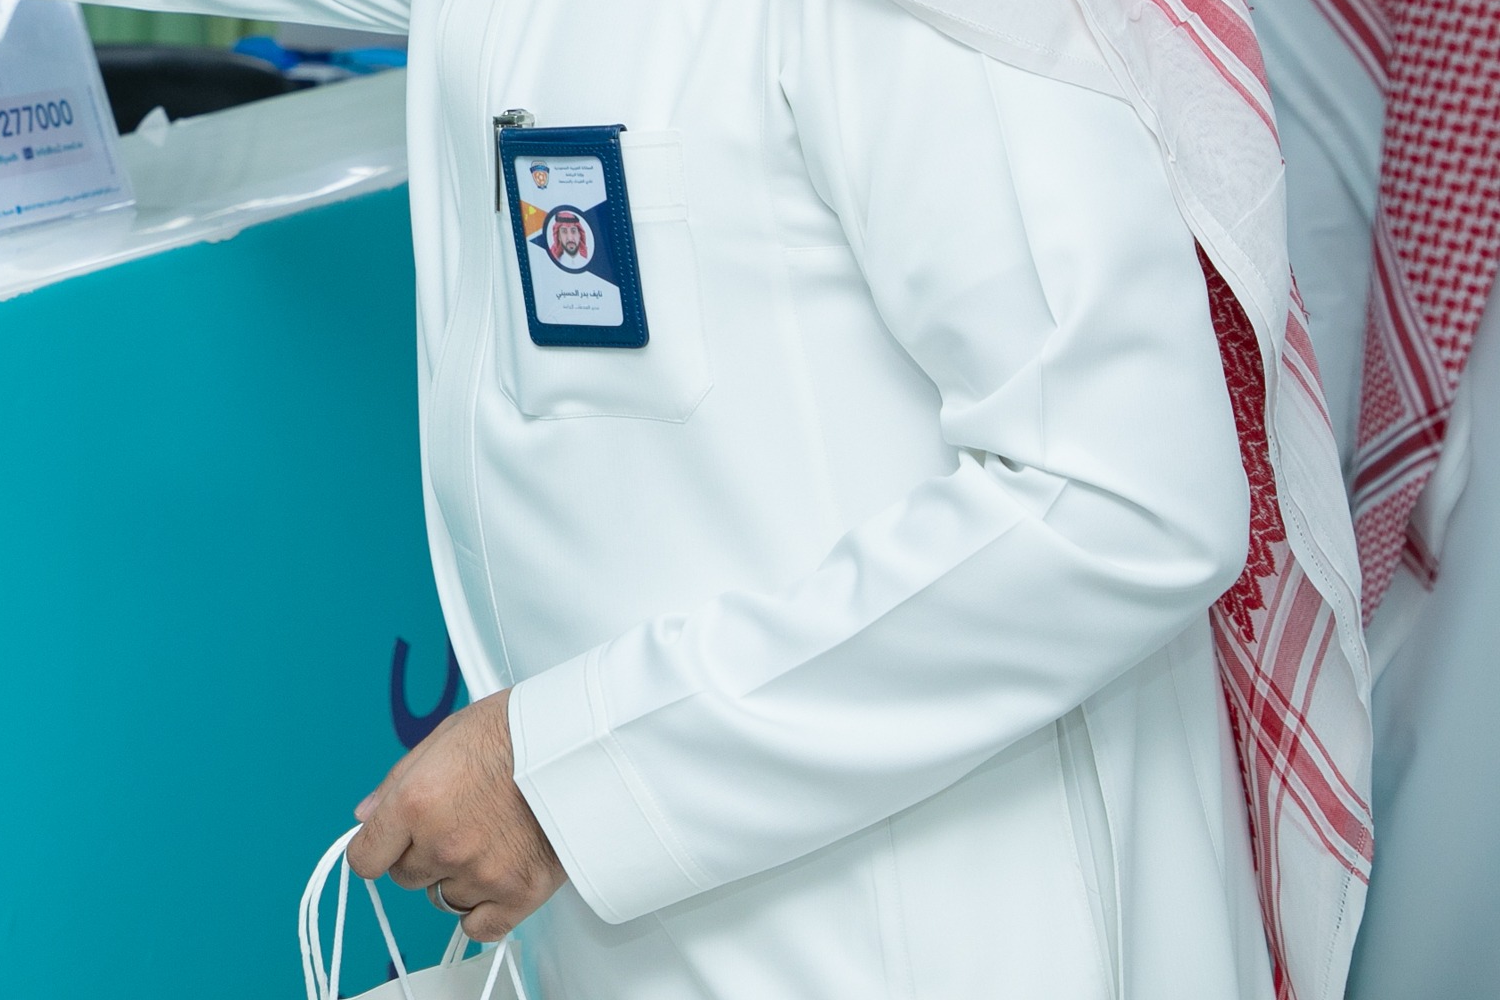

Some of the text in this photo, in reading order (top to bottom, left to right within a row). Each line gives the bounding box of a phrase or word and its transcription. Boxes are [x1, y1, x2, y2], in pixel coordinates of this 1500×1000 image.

[555, 289, 603, 300] نايف بدر الحسيني
